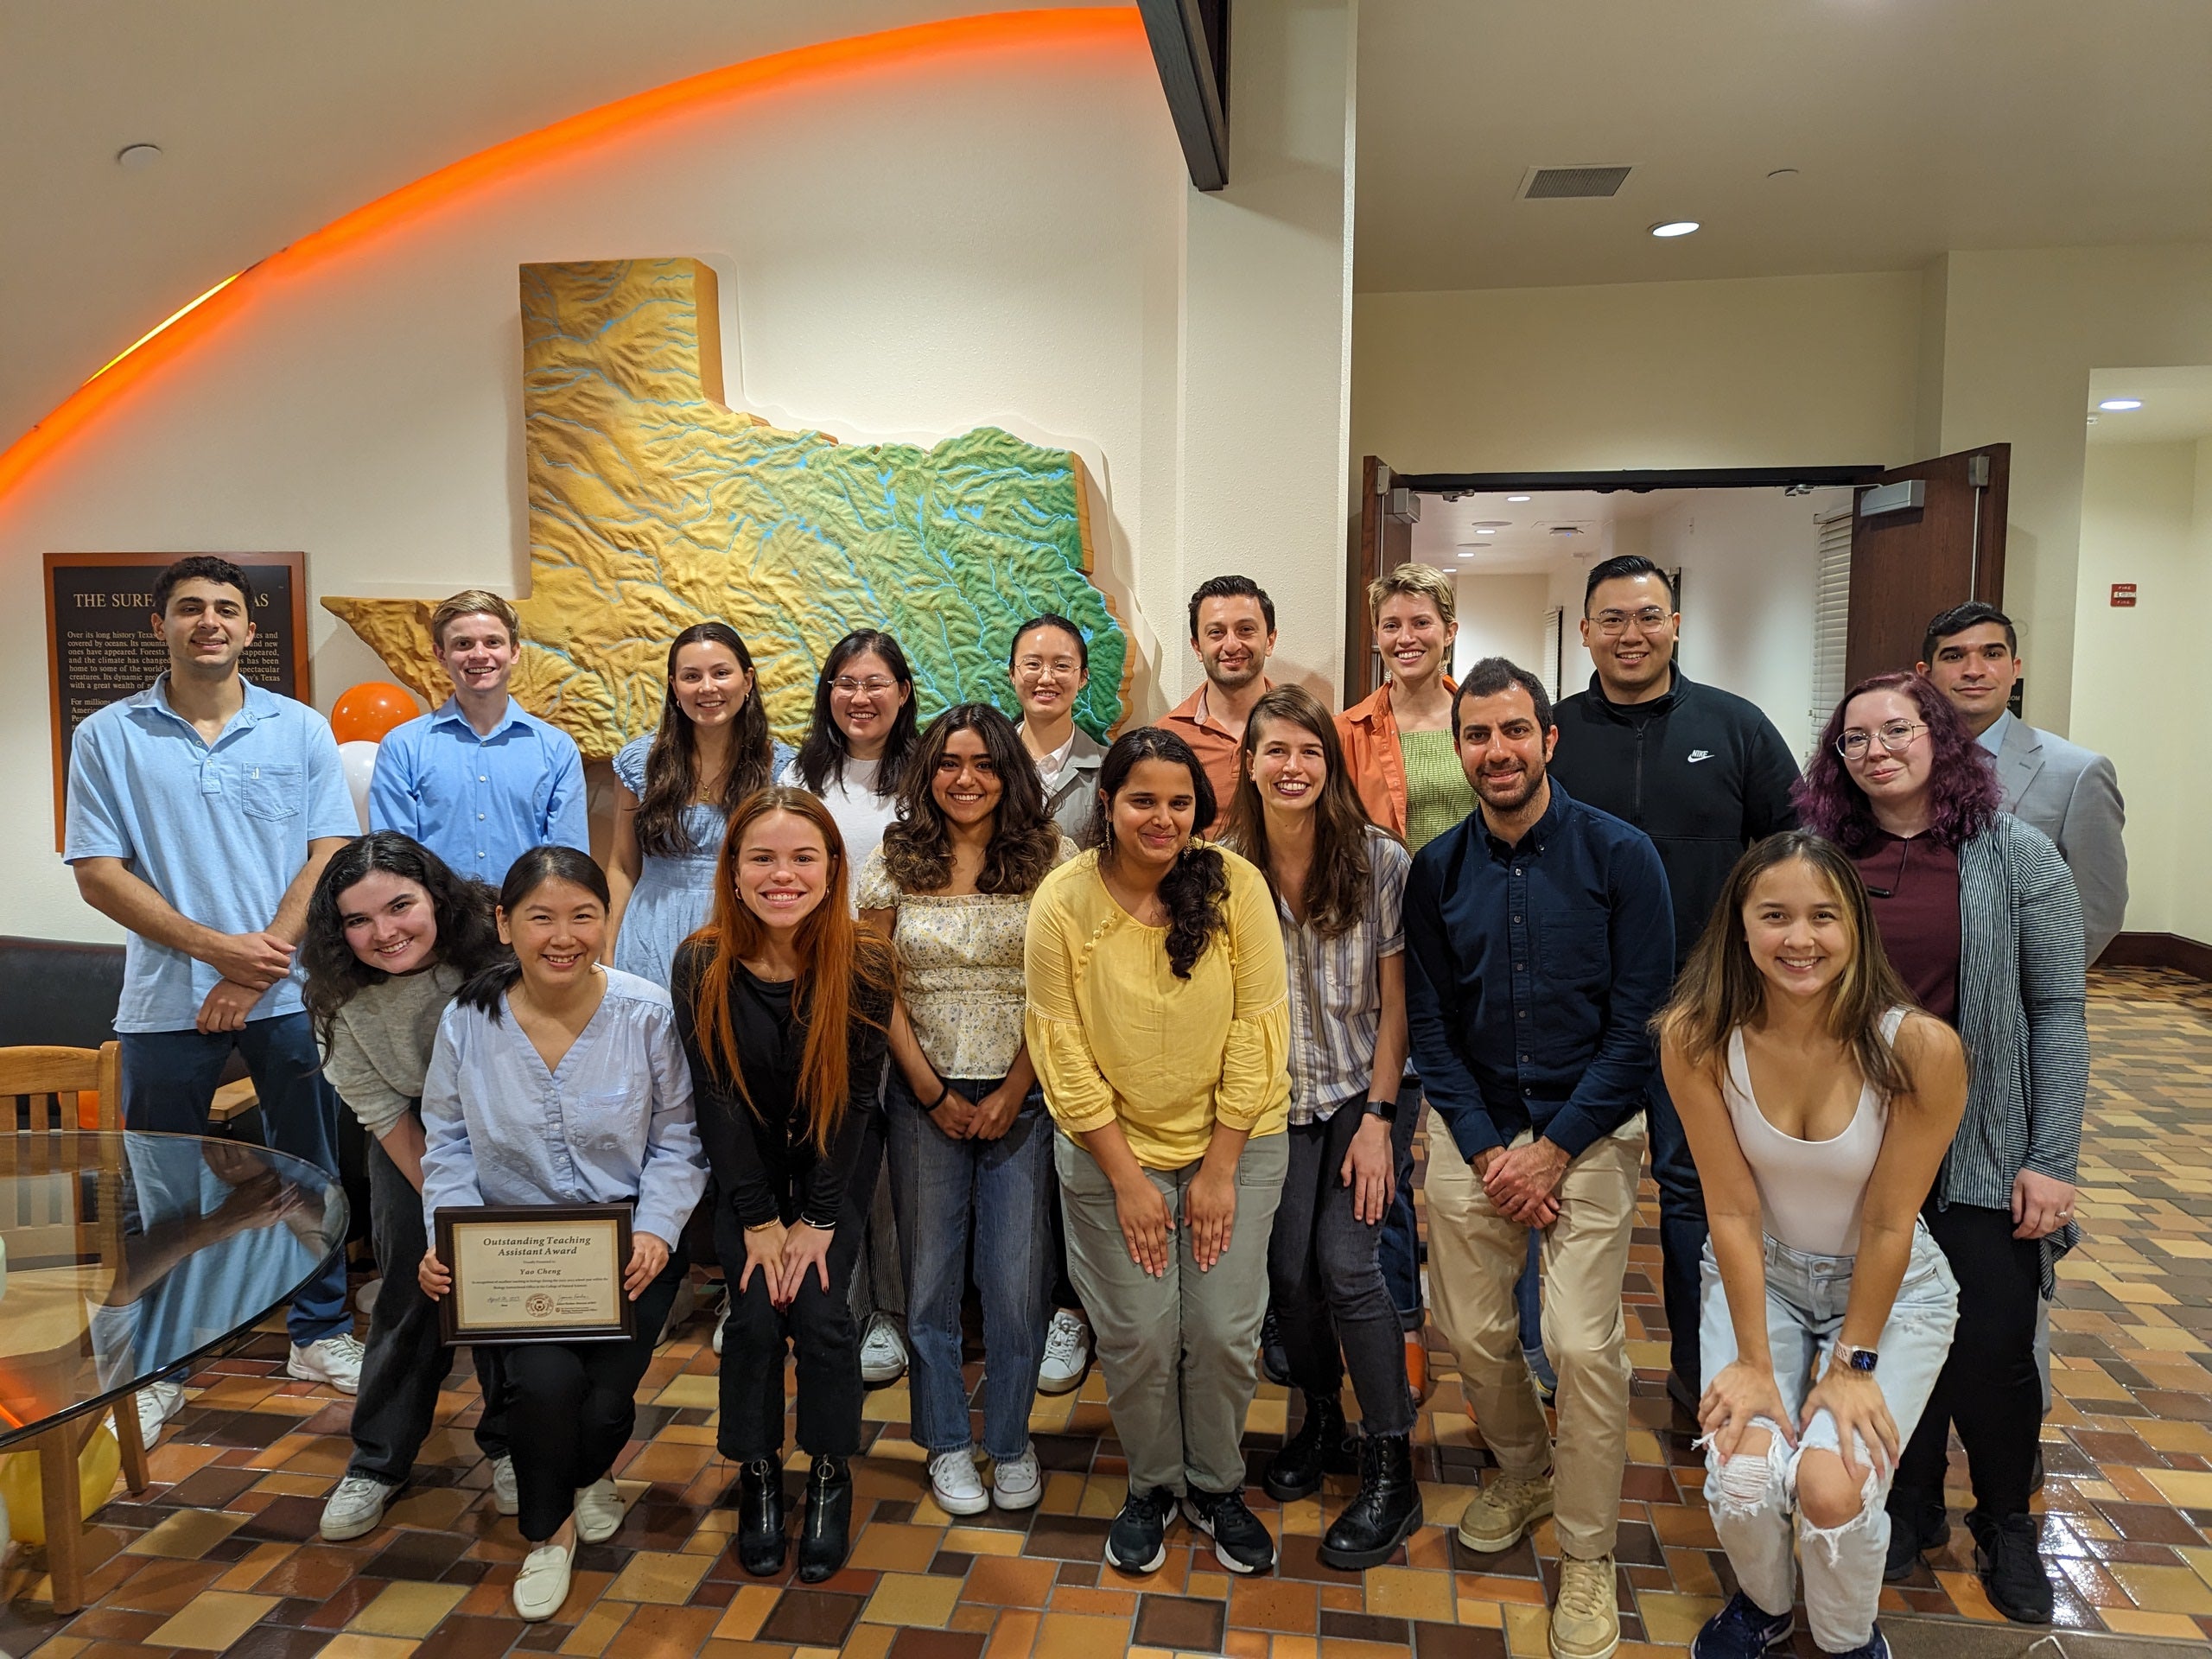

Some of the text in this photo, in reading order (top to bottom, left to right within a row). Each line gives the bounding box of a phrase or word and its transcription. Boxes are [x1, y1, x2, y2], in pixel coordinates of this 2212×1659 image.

[73, 594, 106, 607] THE
[111, 594, 156, 607] SURF
[113, 673, 143, 682] dynamic
[1691, 749, 1709, 758] NIKE
[483, 1236, 591, 1247] Outstanding Teaching
[498, 1246, 577, 1256] Assistant Award
